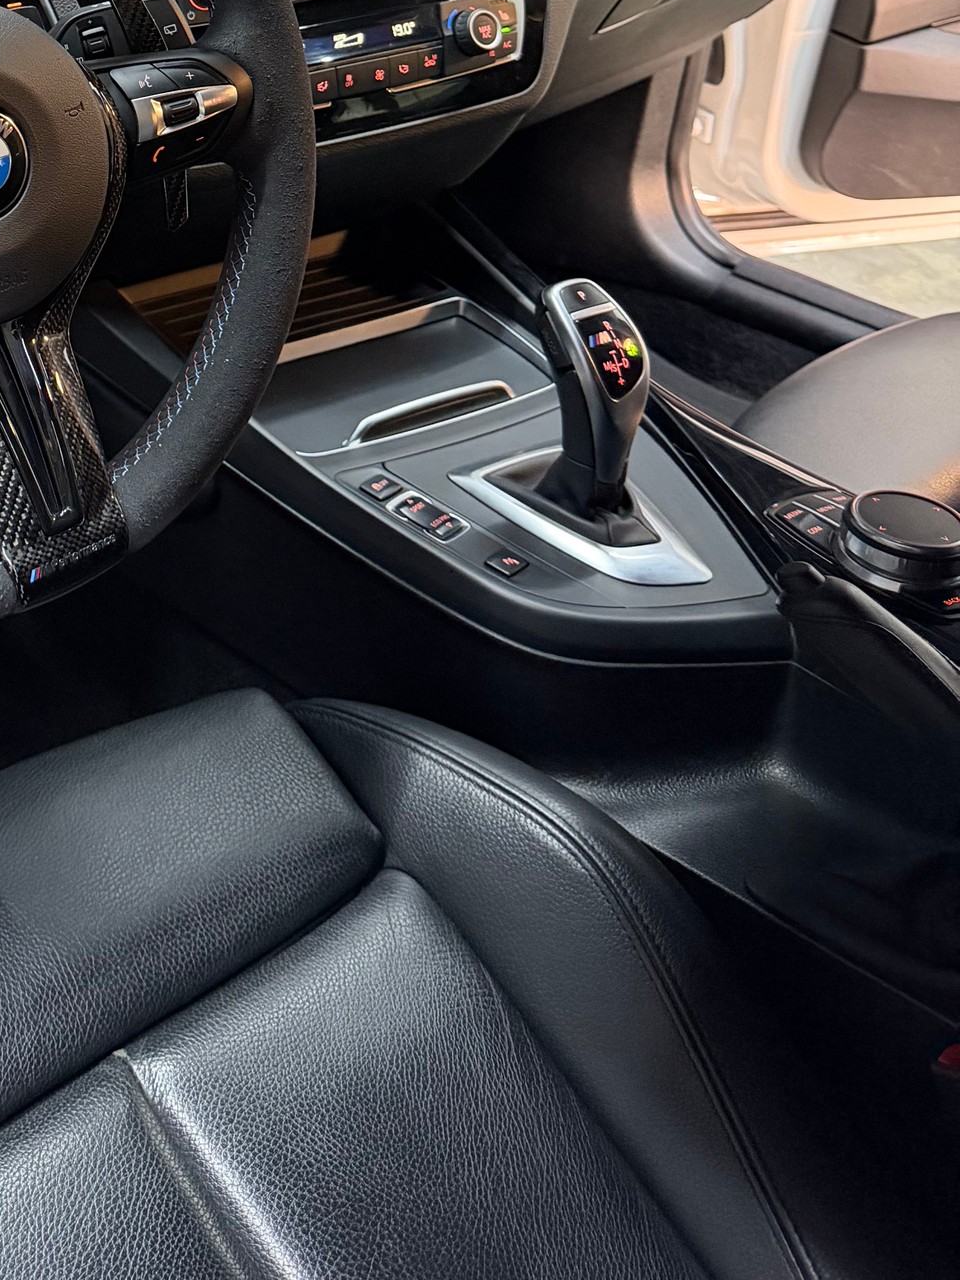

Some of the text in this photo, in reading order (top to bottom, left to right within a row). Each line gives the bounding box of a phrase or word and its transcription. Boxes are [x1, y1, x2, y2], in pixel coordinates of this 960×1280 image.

[576, 290, 586, 301] P
[621, 358, 630, 369] D
[807, 525, 823, 535] COM
